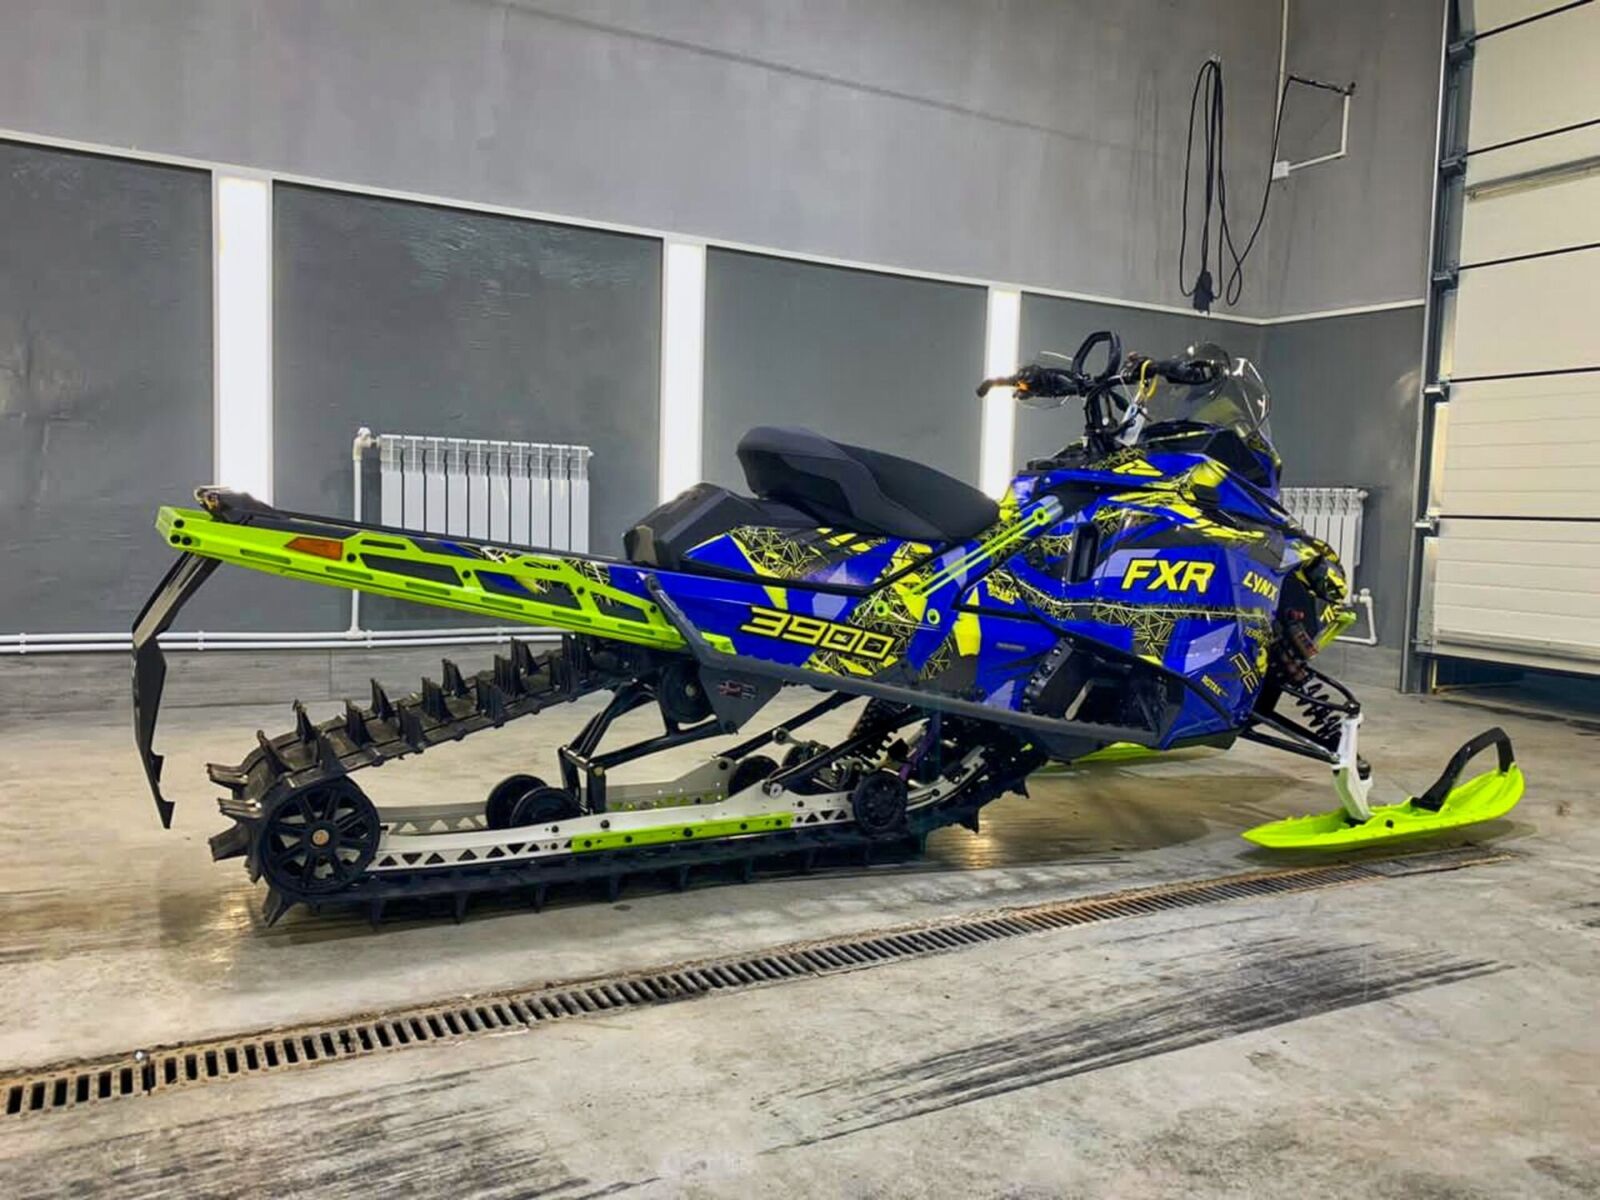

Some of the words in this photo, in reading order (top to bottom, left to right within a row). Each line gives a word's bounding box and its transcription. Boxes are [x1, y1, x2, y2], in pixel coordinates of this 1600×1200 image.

[1120, 558, 1216, 594] FXR
[1242, 570, 1279, 601] LYNX
[739, 605, 897, 661] 3900
